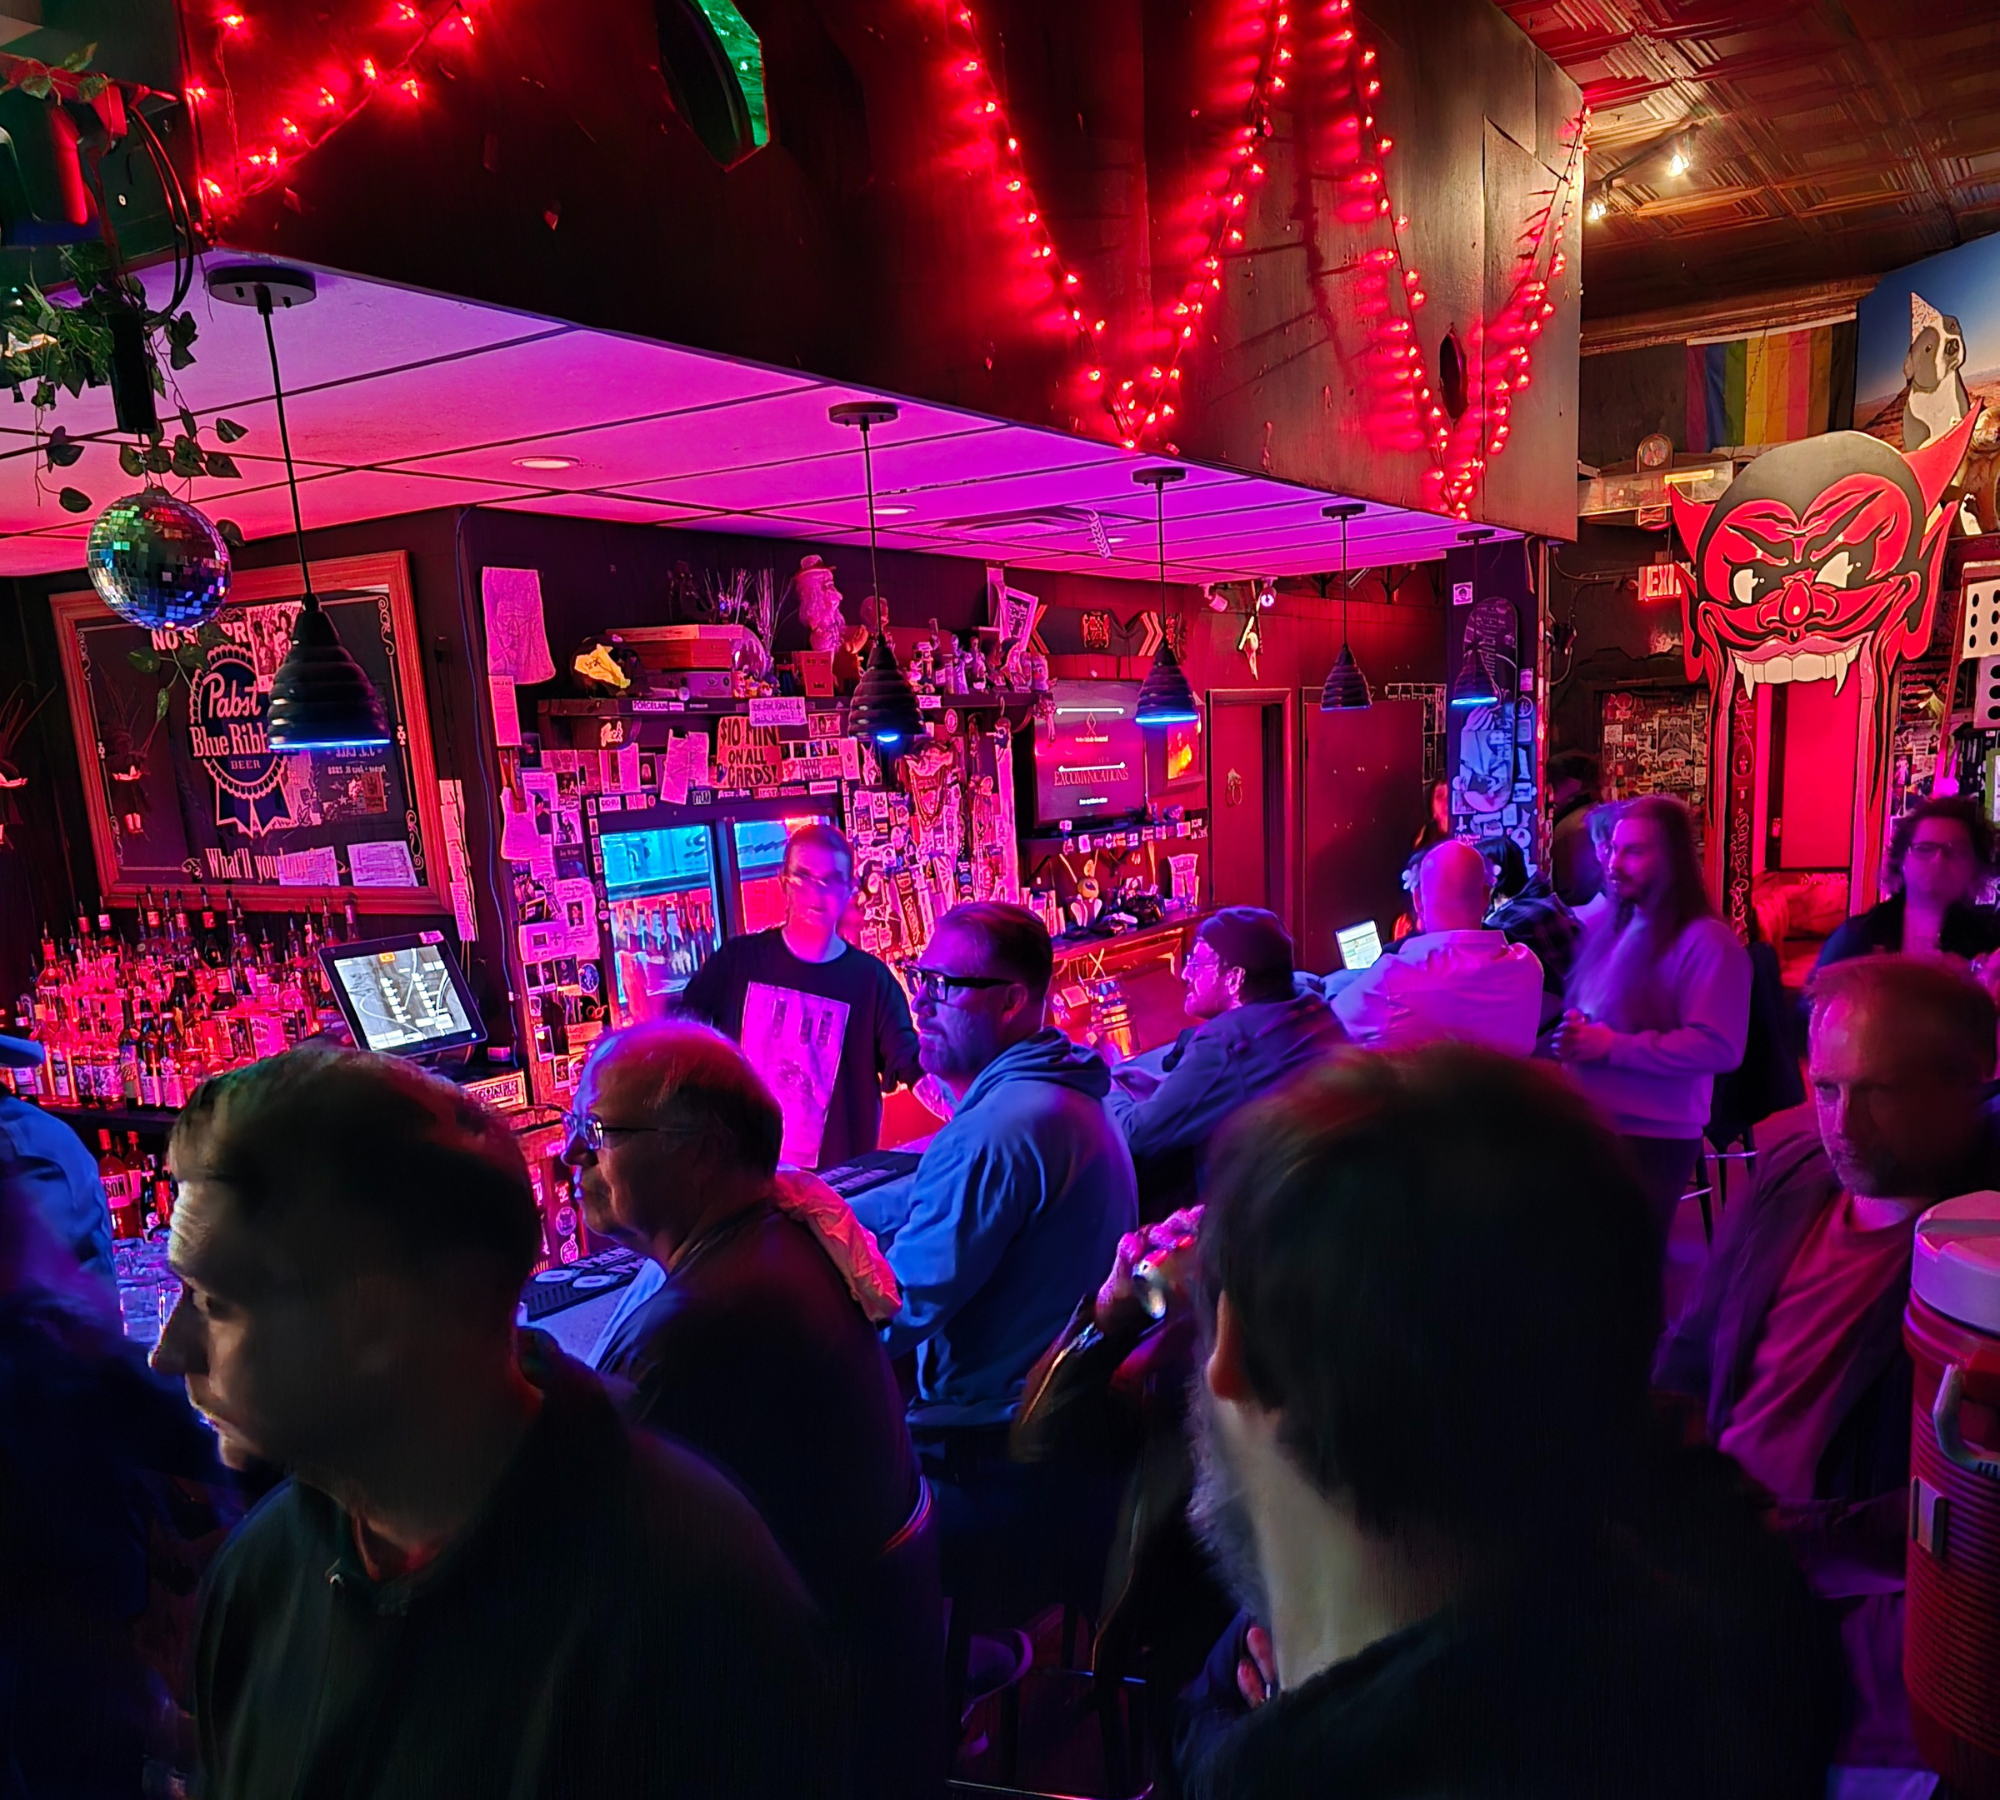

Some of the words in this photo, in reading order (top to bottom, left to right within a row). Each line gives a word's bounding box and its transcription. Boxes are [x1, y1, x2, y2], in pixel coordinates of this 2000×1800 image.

[151, 628, 180, 651] NO
[202, 672, 262, 719] Pabst
[633, 701, 668, 711] PORCELAIN
[189, 725, 229, 757] Blue
[228, 721, 280, 754] Ribb
[720, 717, 741, 746] $10
[745, 718, 778, 747] MIN
[230, 759, 261, 769] BEER
[728, 748, 744, 765] ON
[744, 748, 768, 765] ALL
[727, 764, 778, 787] CARDS!
[205, 848, 254, 879] What'll
[254, 855, 279, 884] you
